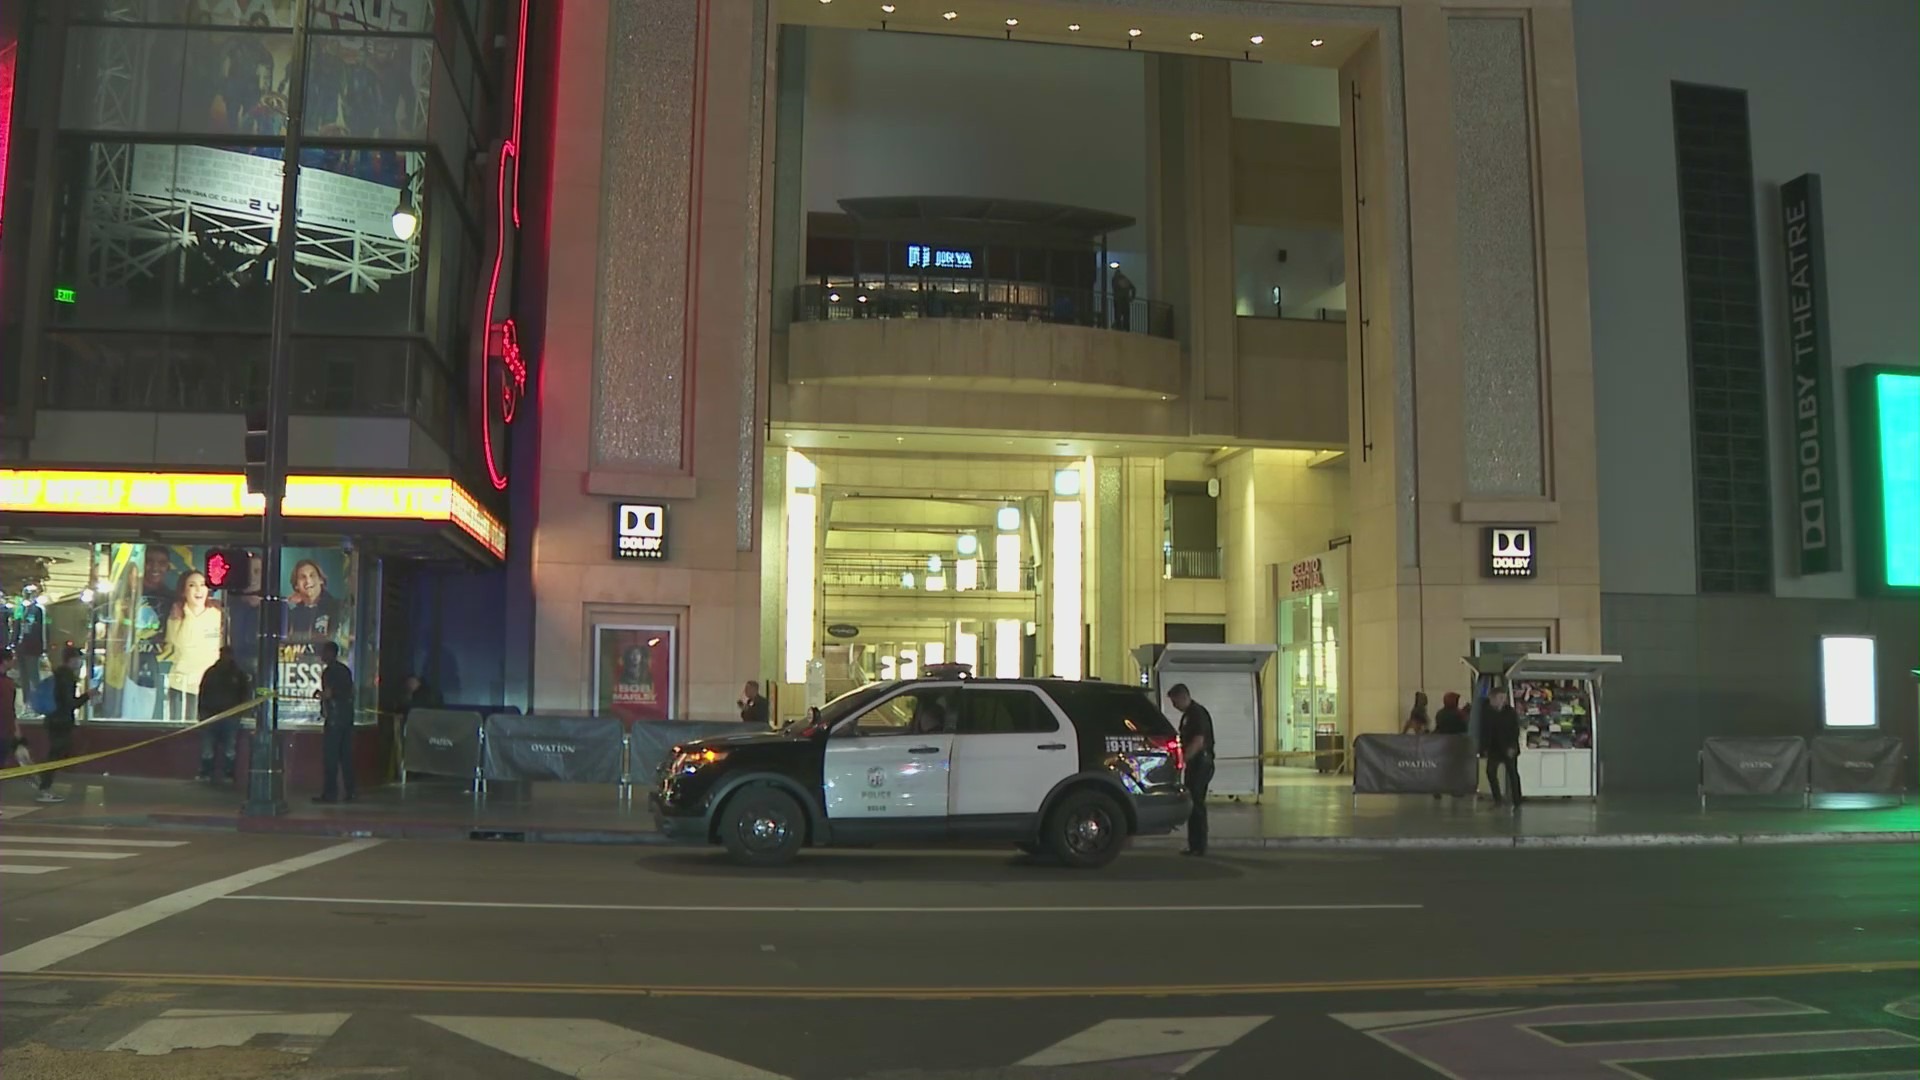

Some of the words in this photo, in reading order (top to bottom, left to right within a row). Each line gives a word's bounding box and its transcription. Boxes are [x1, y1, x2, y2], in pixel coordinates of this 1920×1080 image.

[1787, 200, 1813, 364] THEATRE
[1797, 376, 1820, 493] DOLBY
[620, 536, 662, 550] DOLBY
[620, 550, 662, 558] THEATRE
[1293, 558, 1321, 577] GELATO
[1493, 557, 1530, 568] DOLBY
[1291, 573, 1323, 592] FESTIVAL
[619, 684, 650, 693] BOB
[531, 742, 576, 753] OVATION
[1398, 759, 1437, 768] OVATION
